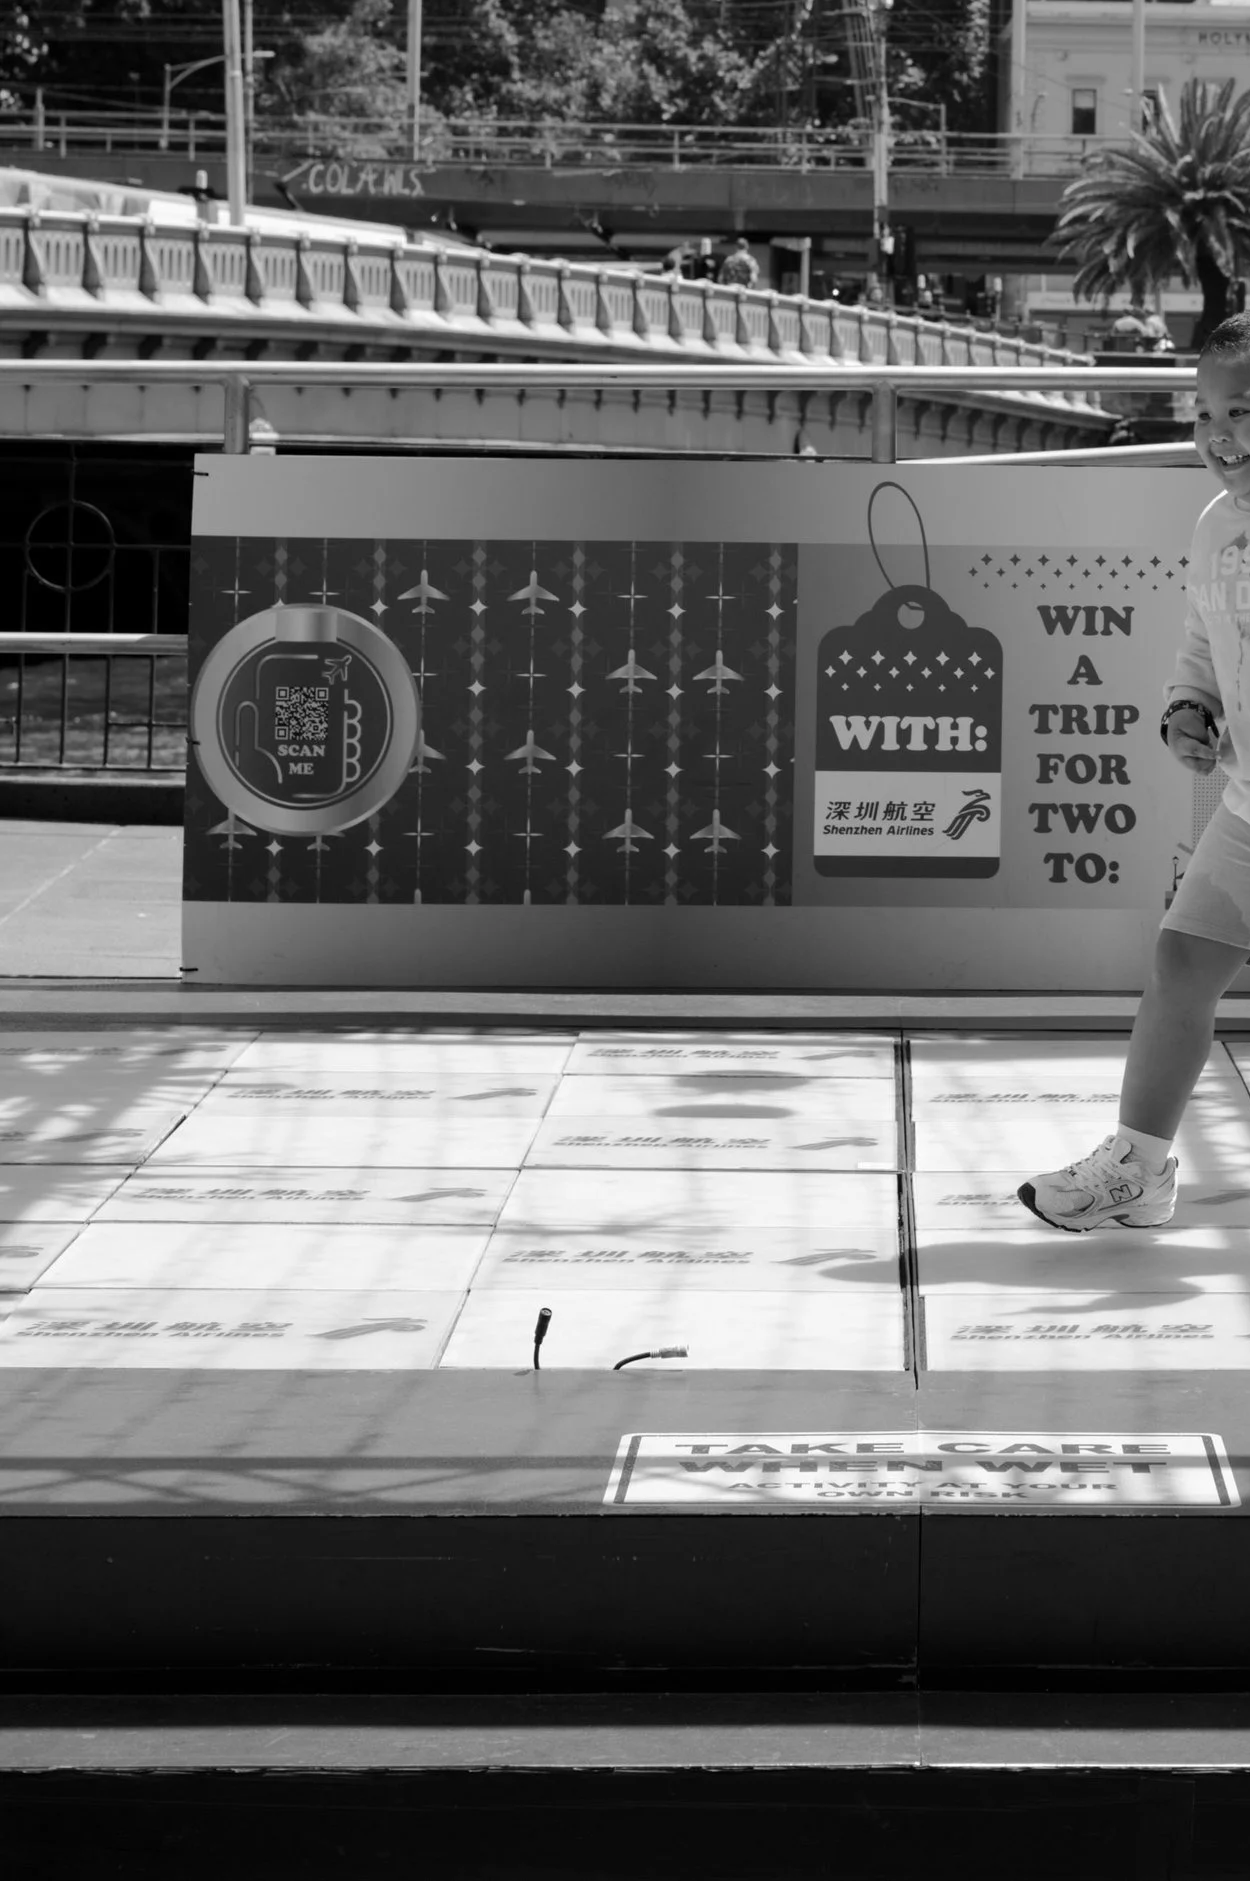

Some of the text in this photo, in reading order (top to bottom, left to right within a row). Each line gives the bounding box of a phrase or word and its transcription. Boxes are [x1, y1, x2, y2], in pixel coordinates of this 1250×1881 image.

[1036, 605, 1135, 636] WIN
[1066, 654, 1104, 685] A
[1028, 703, 1141, 735] TRIP
[828, 715, 988, 751] WITH:
[277, 744, 326, 757] SCAN
[288, 762, 315, 775] ME
[1035, 753, 1132, 785] FOR
[825, 801, 936, 821] 深圳航空
[1028, 802, 1137, 835] TWO
[822, 824, 935, 837] Shenzhen Airlines
[1042, 852, 1120, 884] TO:
[14, 1330, 160, 1338] Shenzhen
[674, 1442, 1171, 1455] TAKE CARE
[678, 1459, 1167, 1474] WHEN WET
[728, 1481, 1117, 1491] ACTIVITY AT YOUR
[816, 1490, 913, 1498] OWN
